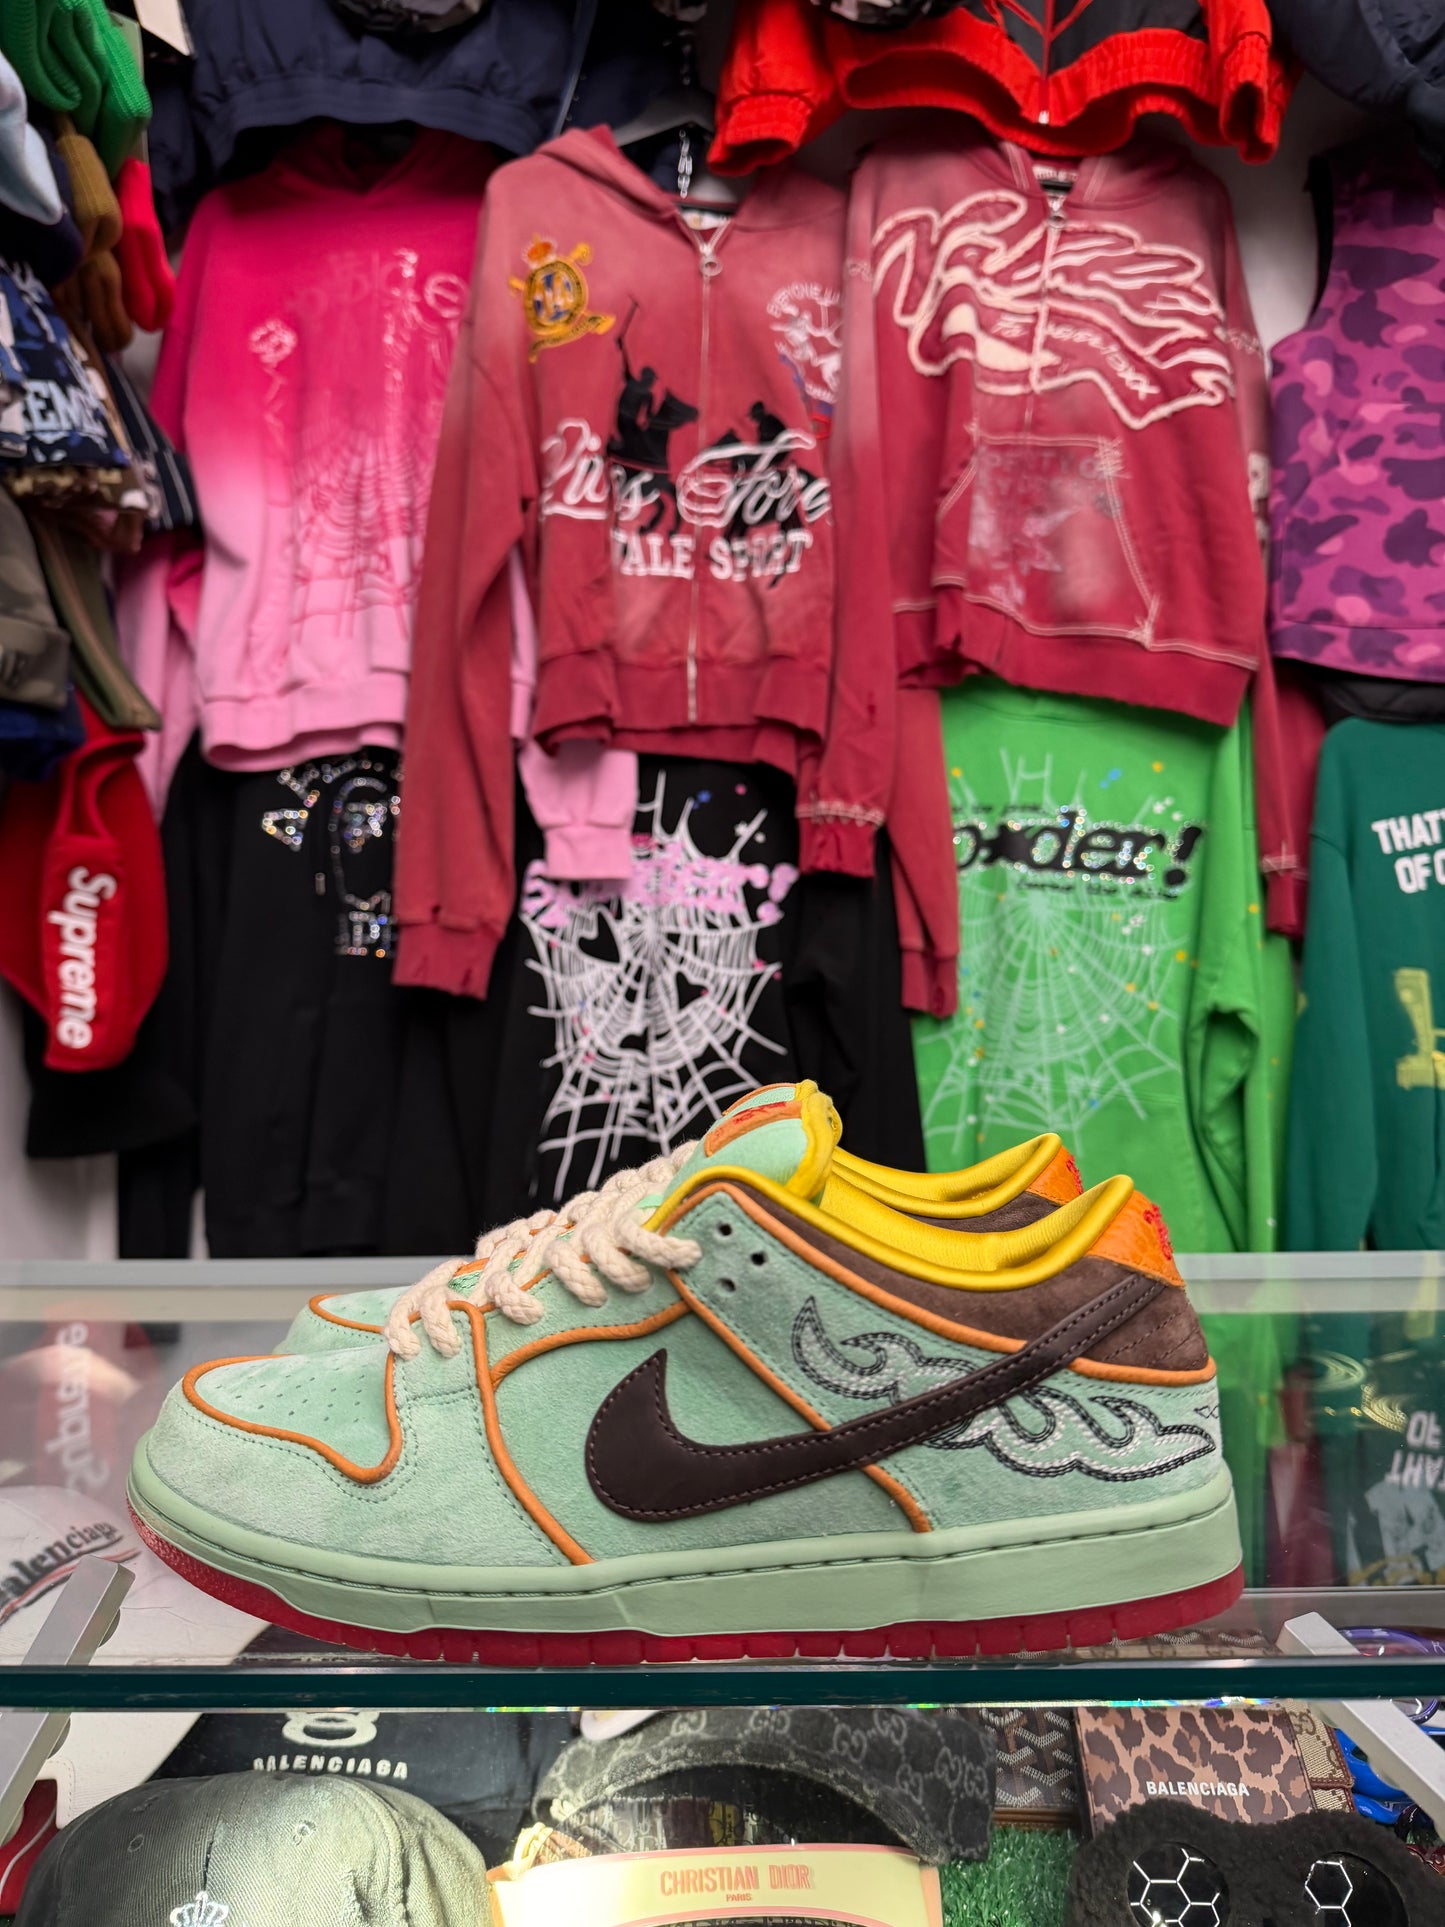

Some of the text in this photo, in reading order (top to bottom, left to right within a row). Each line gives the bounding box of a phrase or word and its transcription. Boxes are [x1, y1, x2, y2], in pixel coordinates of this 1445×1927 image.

[1394, 852, 1432, 894] OF
[47, 865, 118, 1050] Supreme
[1145, 1780, 1250, 1797] BALENCIAGA
[660, 1863, 812, 1897] CHRISTIAN DIOR
[725, 1892, 753, 1903] PARIS
